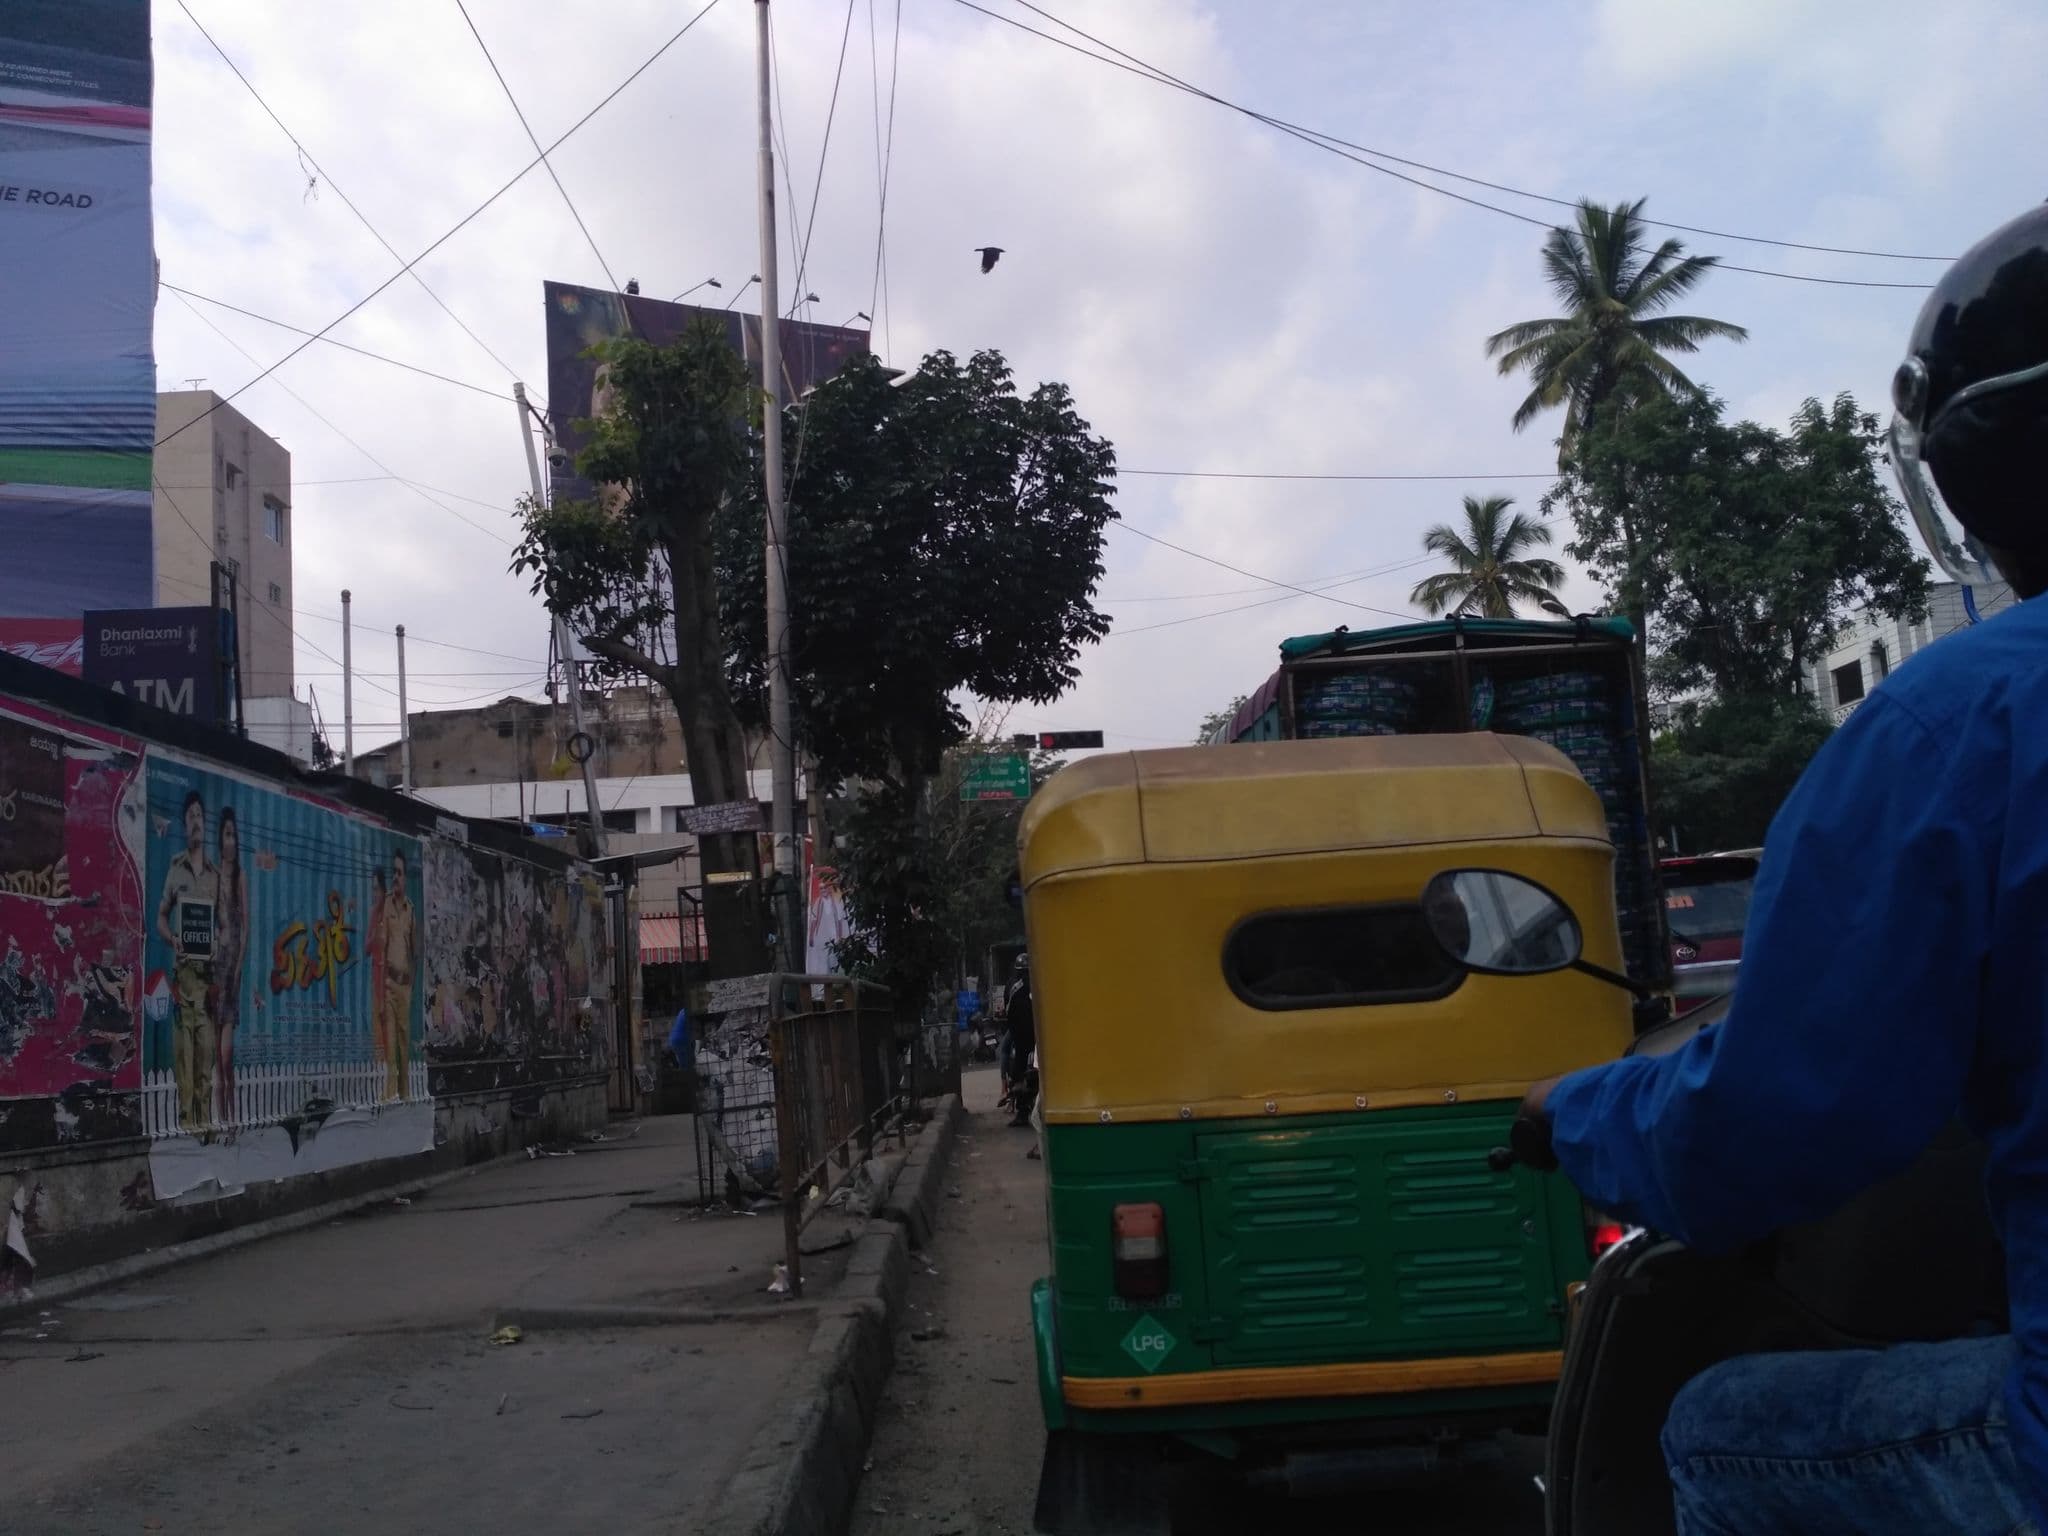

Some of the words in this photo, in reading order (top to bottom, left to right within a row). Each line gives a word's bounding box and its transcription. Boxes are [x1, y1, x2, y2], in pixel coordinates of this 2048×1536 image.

[26, 189, 92, 209] ROAD
[101, 625, 182, 641] Dhanlaxmi
[100, 642, 136, 657] Bank
[183, 930, 210, 944] OFFICER
[1132, 1334, 1165, 1352] LPG
